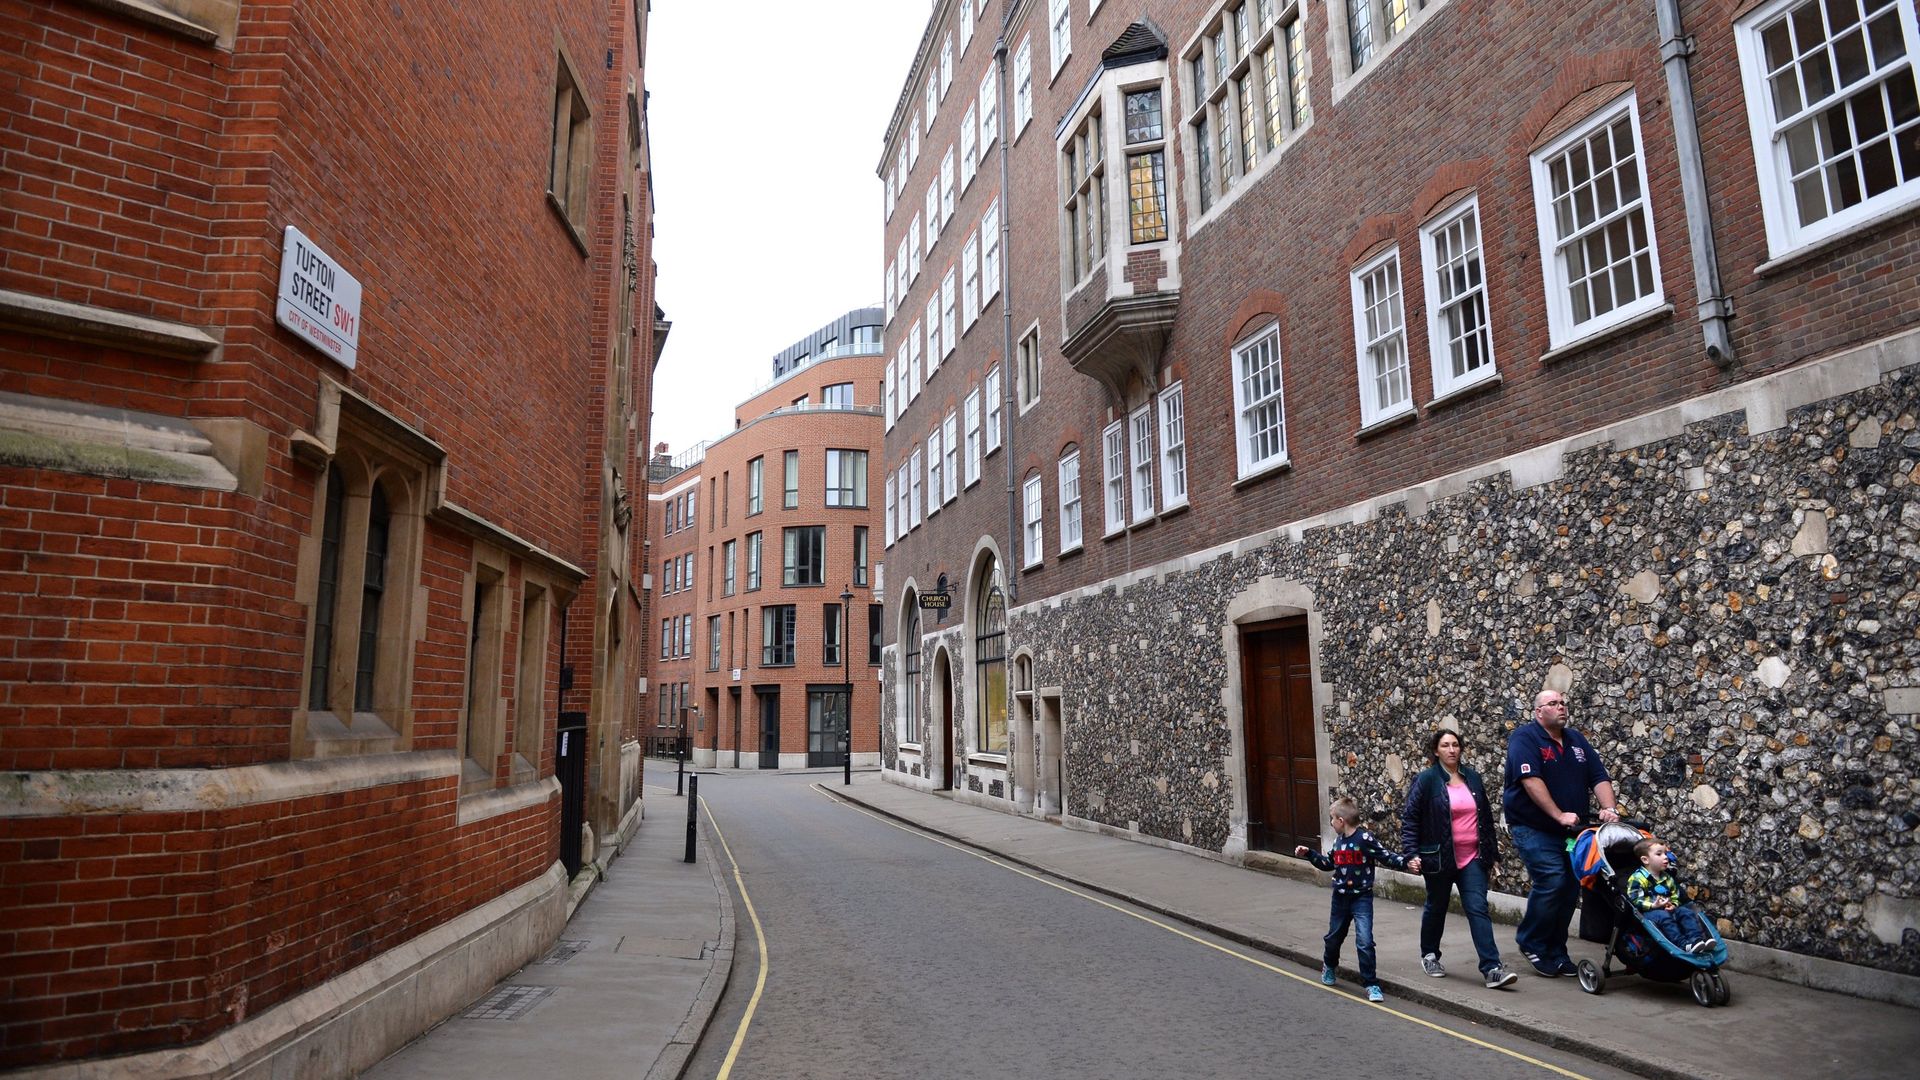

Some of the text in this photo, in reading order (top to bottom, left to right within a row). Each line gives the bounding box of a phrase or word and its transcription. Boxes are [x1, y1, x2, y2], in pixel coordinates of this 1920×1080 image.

[296, 241, 335, 292] TUFTON
[292, 272, 354, 336] STREET SW1
[288, 310, 341, 354] CITY OF WESTMINSTER
